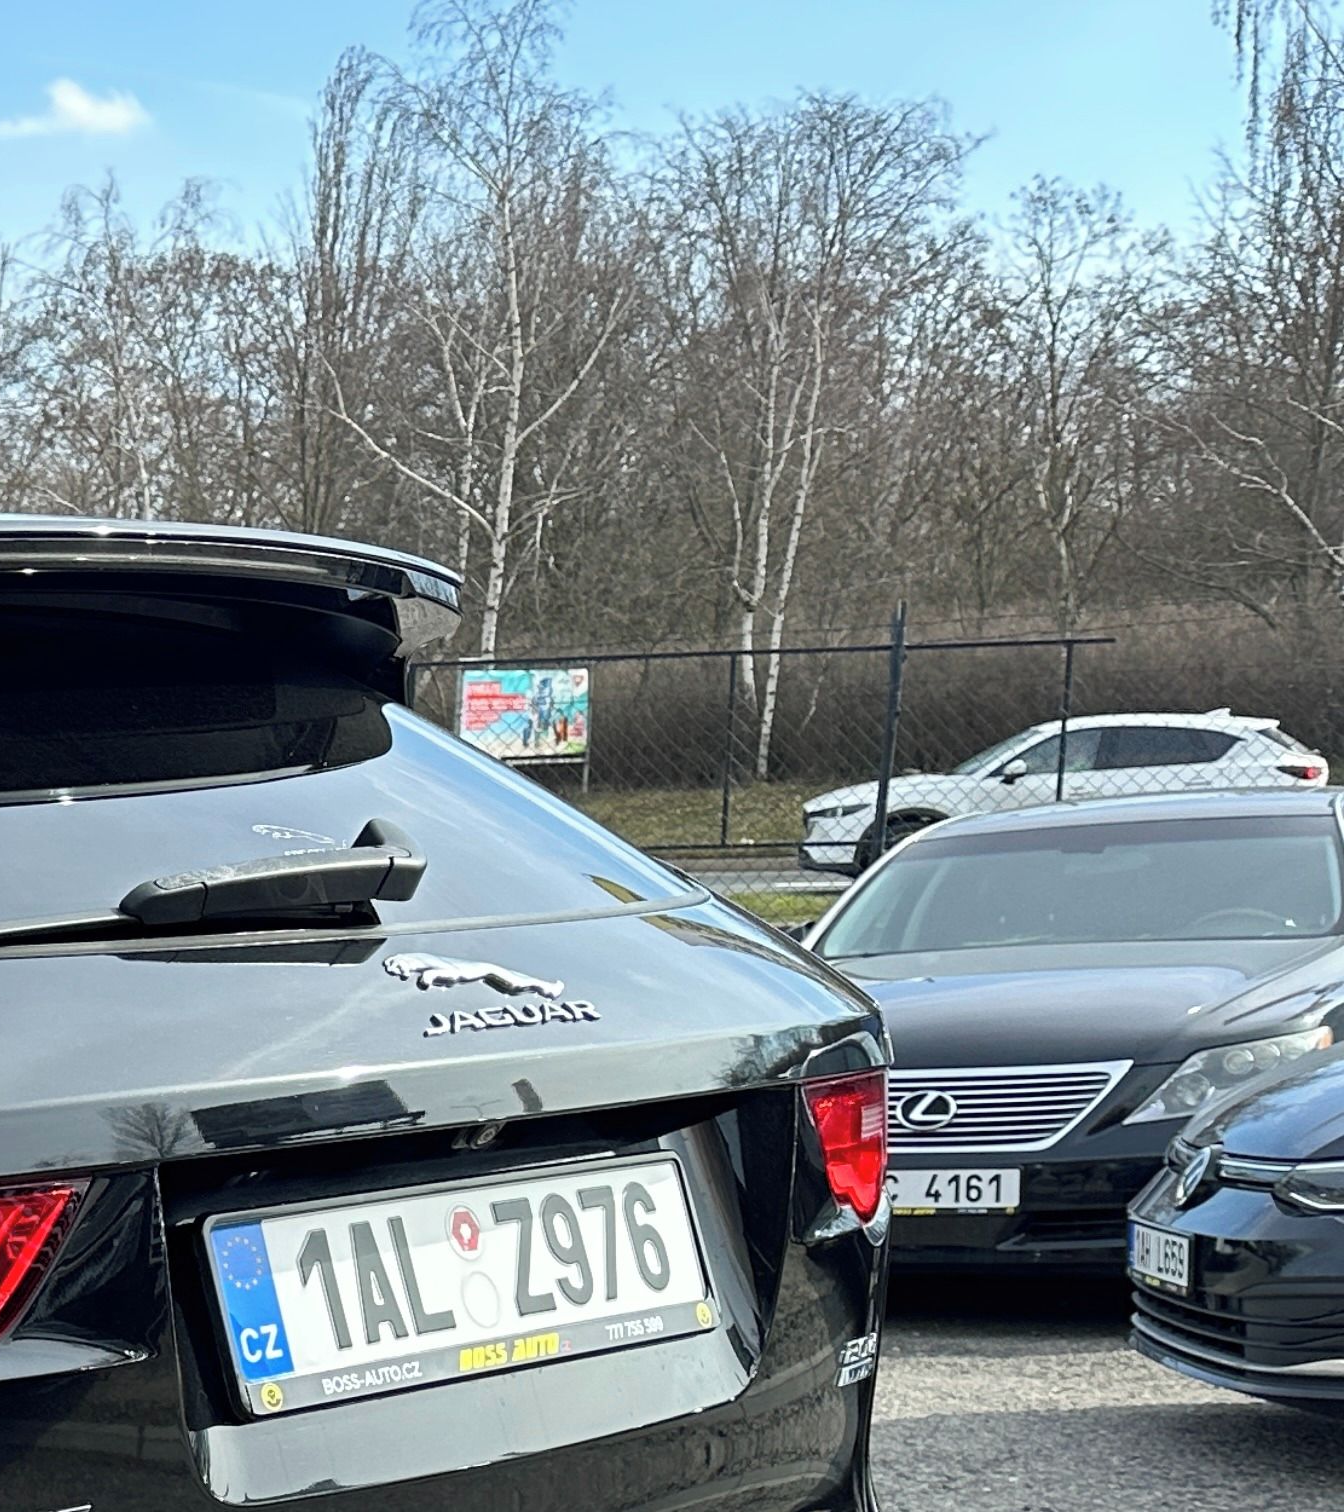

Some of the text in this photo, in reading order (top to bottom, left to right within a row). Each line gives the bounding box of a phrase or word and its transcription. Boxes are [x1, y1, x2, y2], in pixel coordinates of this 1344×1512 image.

[423, 1000, 602, 1038] JAGUAR
[925, 1174, 1002, 1203] 4161
[297, 1181, 671, 1350] 1AL Z976
[1157, 1236, 1185, 1279] L659
[240, 1323, 284, 1363] CZ
[322, 1361, 423, 1396] BOSS-AUTO.CZ
[459, 1342, 508, 1373] BOSS
[512, 1332, 560, 1362] AUTO
